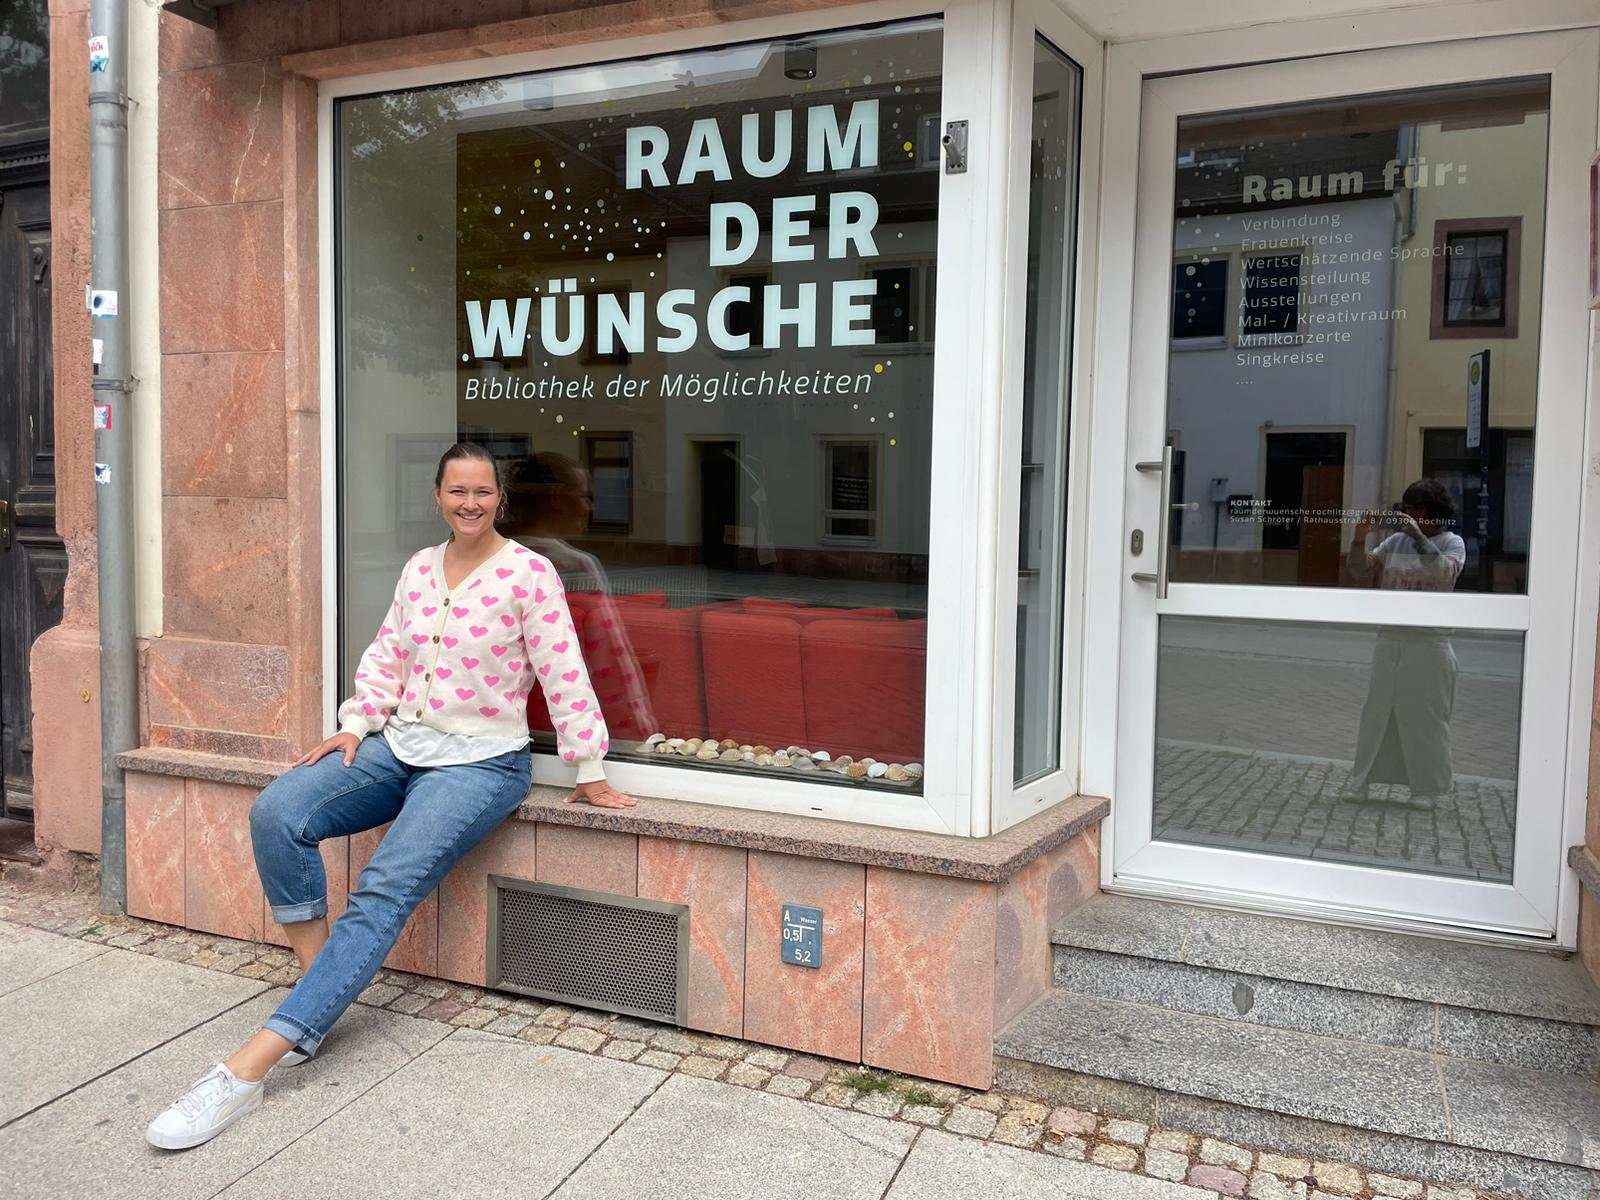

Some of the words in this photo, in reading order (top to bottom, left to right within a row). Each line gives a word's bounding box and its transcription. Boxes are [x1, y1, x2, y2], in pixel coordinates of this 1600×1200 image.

[625, 98, 881, 190] RAUM
[1242, 170, 1364, 204] Raum
[1382, 157, 1467, 191] für:
[708, 191, 881, 268] DER
[1242, 213, 1342, 232] Verbindung
[1241, 231, 1354, 251] Frauenkreise
[1240, 249, 1383, 271] Wertschätzende
[1390, 242, 1466, 262] Sprache
[1239, 269, 1372, 290] Wissensteilung
[1239, 290, 1362, 311] Ausstellungen
[464, 277, 879, 359] WÜNSCHE
[1297, 306, 1407, 325] Kreativraum
[1237, 330, 1352, 348] Minikonzerte
[1236, 351, 1325, 369] Singkreise
[464, 375, 594, 401] Bibliothek
[605, 376, 650, 398] der
[659, 370, 874, 402] Möglichkeiten
[1230, 515, 1255, 523] Susan
[1303, 516, 1367, 524] Rathausstraße
[1418, 517, 1457, 526] Rochlitz
[784, 910, 790, 922] A
[783, 928, 800, 942] 0,5
[795, 949, 811, 963] 5,2
